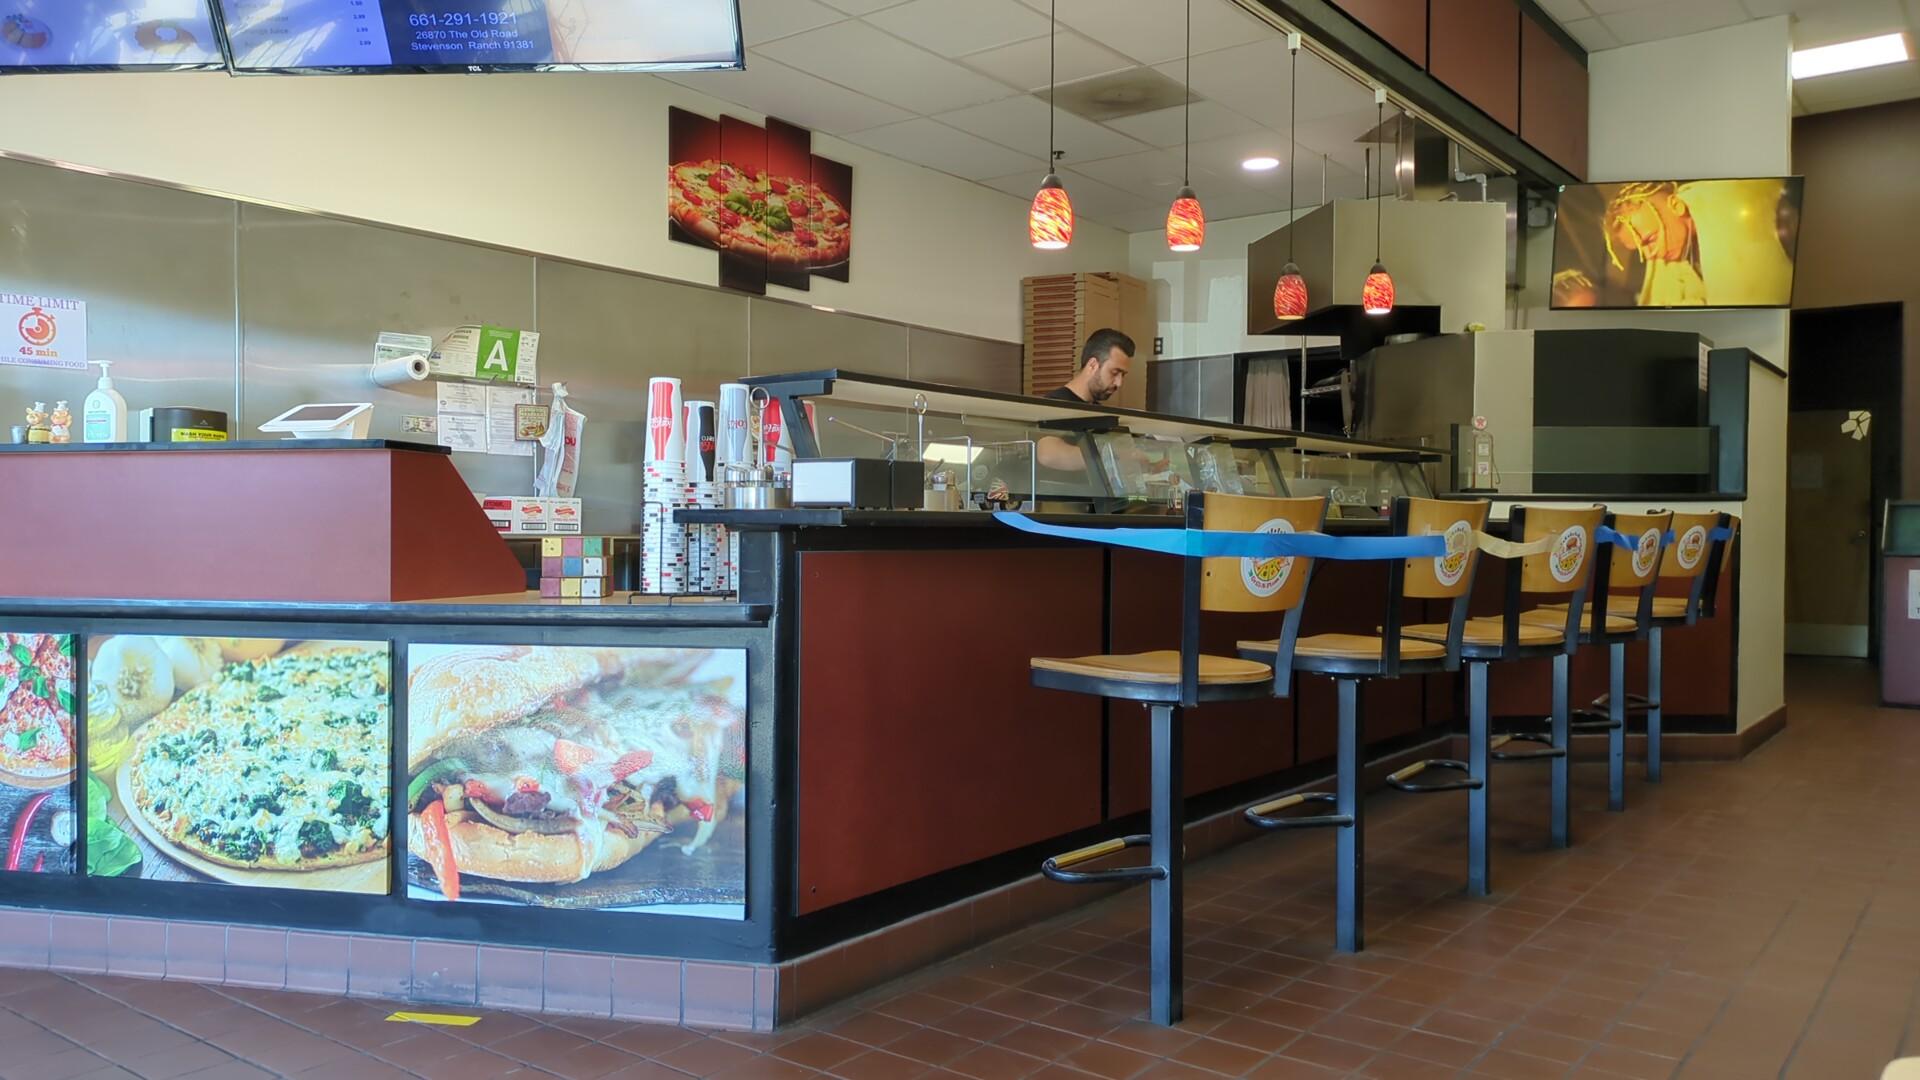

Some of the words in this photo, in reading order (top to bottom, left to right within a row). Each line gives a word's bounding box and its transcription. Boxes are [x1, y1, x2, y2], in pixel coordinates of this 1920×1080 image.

[409, 12, 518, 26] 661-291-1921
[415, 31, 446, 40] 26870
[449, 30, 468, 39] The
[471, 30, 489, 38] Old
[491, 29, 519, 38] Road
[411, 41, 463, 51] Stevenson
[469, 41, 501, 49] Ranch
[503, 40, 535, 49] 91381
[0, 294, 34, 306] TIME
[39, 297, 79, 310] LIMIT
[19, 346, 34, 356] 45
[36, 348, 58, 357] min
[483, 339, 509, 371] A
